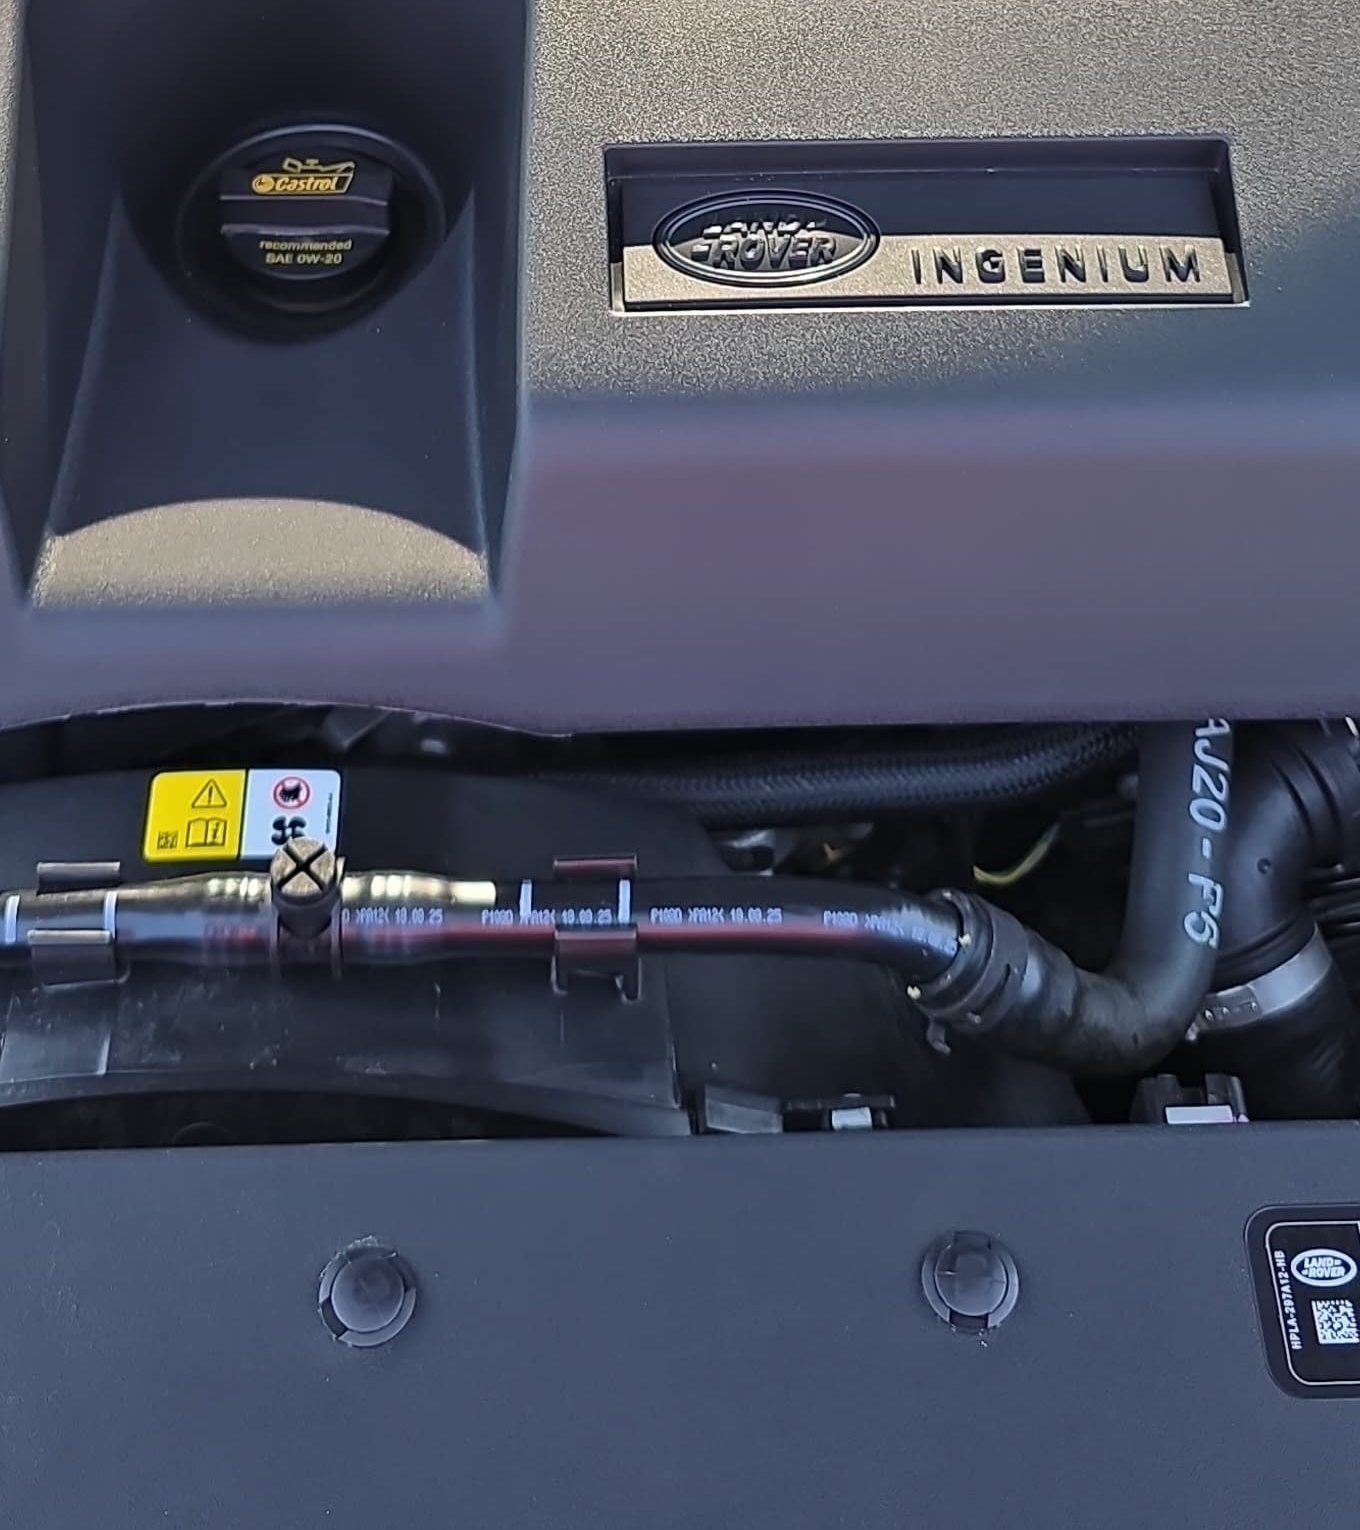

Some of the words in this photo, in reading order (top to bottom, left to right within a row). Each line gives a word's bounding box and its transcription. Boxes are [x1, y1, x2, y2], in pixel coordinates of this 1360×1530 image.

[275, 176, 339, 191] Castrol
[259, 238, 353, 251] recommended
[265, 252, 294, 265] SAE
[296, 252, 343, 265] 0W-20
[711, 234, 837, 271] ROVER
[910, 245, 1203, 286] INGENIUM
[1303, 1256, 1336, 1268] LAND
[1307, 1266, 1346, 1278] ROVER
